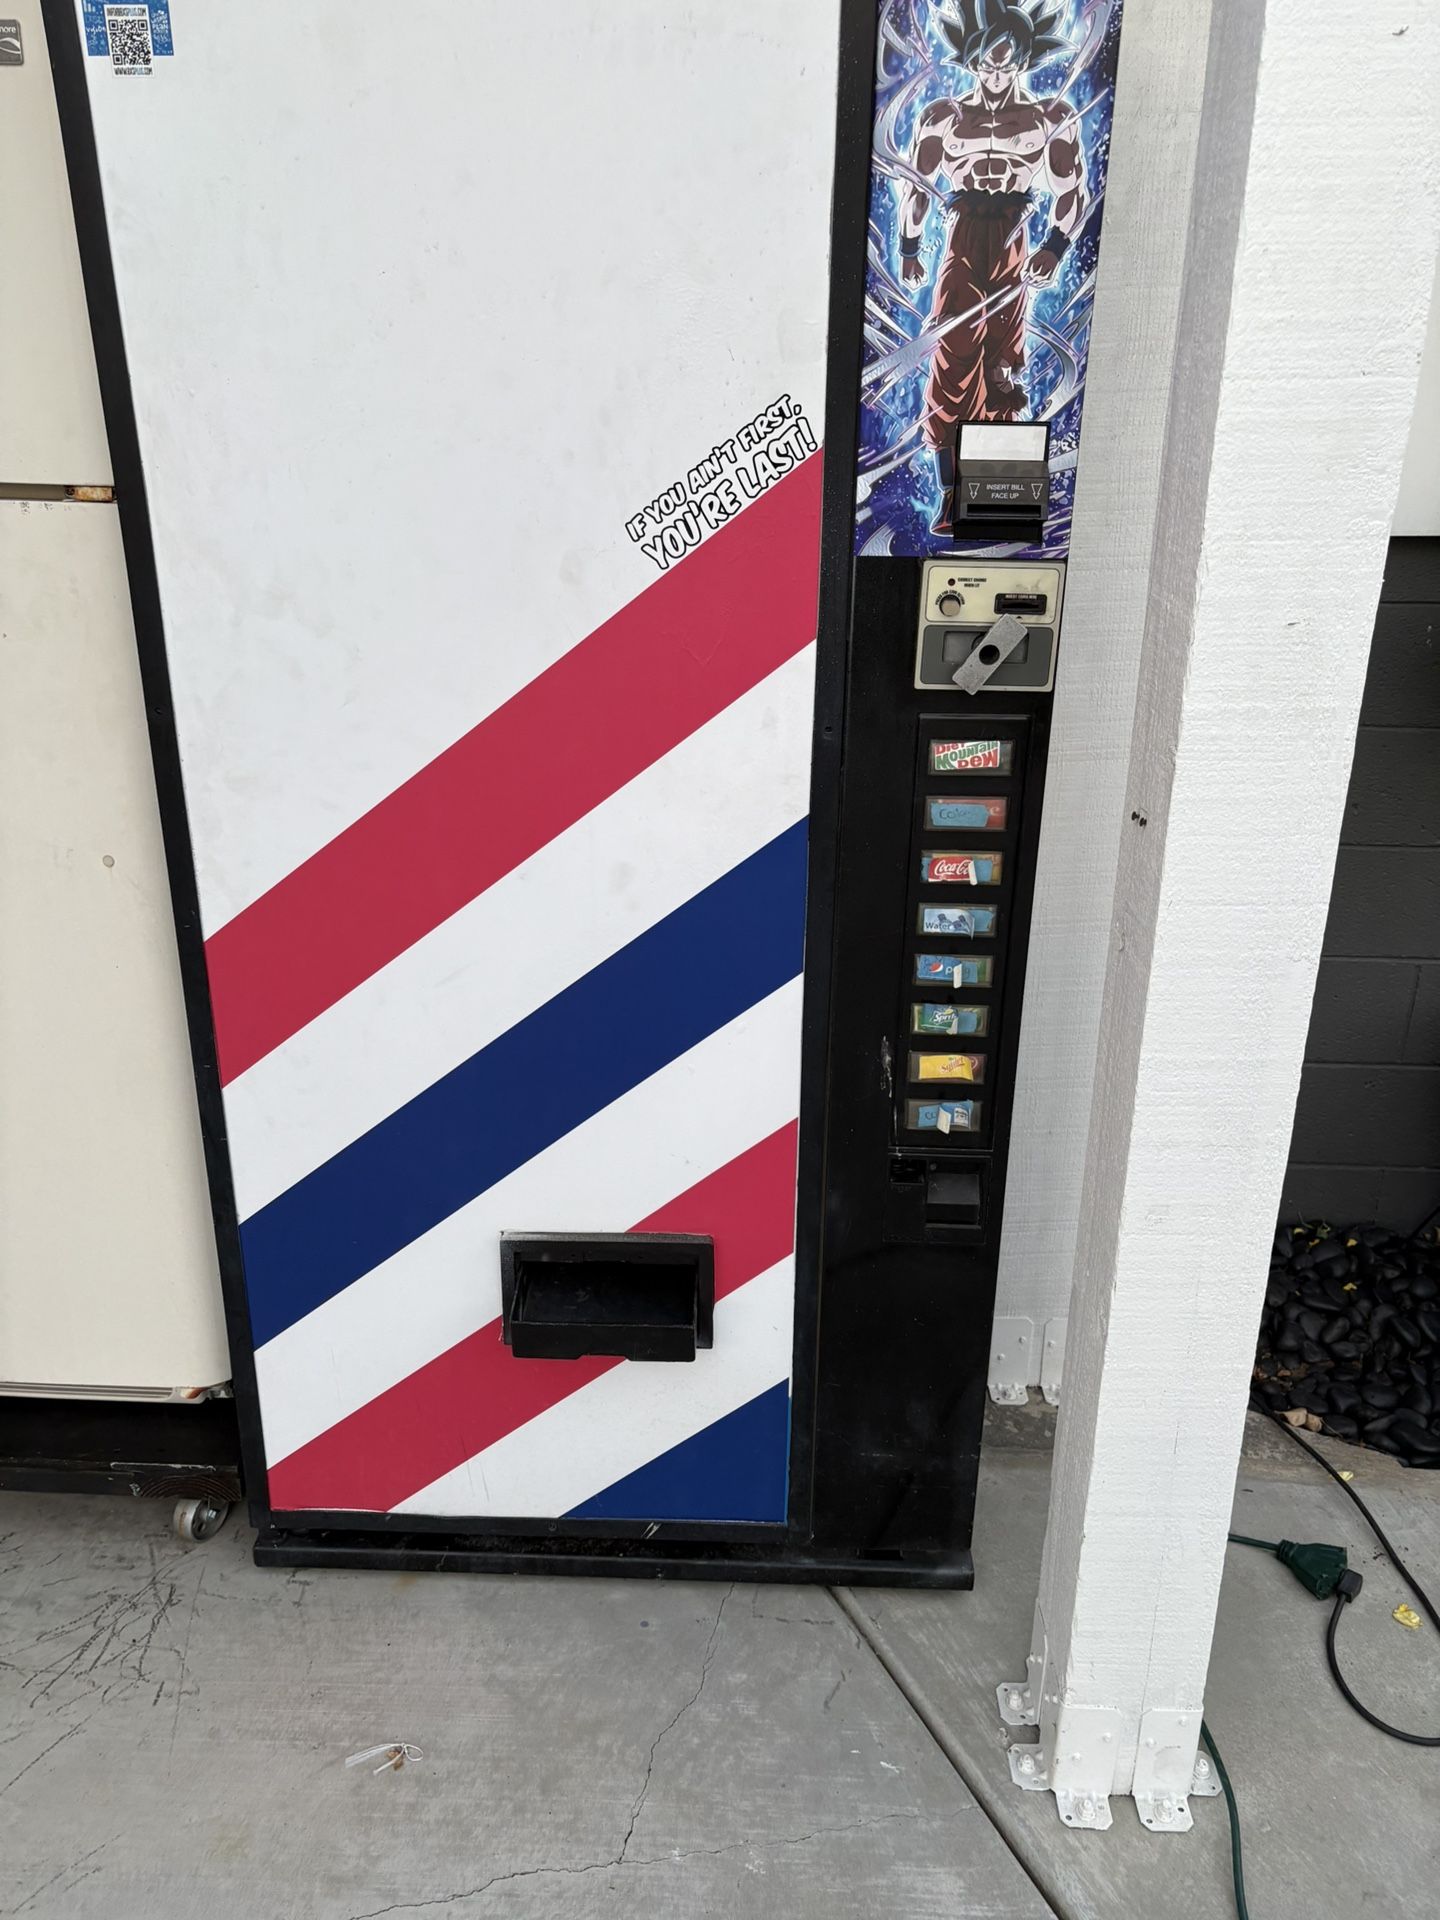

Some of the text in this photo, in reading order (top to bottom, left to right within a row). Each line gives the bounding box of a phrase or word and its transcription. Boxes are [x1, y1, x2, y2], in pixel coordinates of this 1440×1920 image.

[625, 393, 802, 542] IF YOU AIN'T FIRST,
[641, 416, 818, 570] YOU'RE LAST!
[934, 859, 972, 876] Coca-Co
[925, 921, 951, 930] Water
